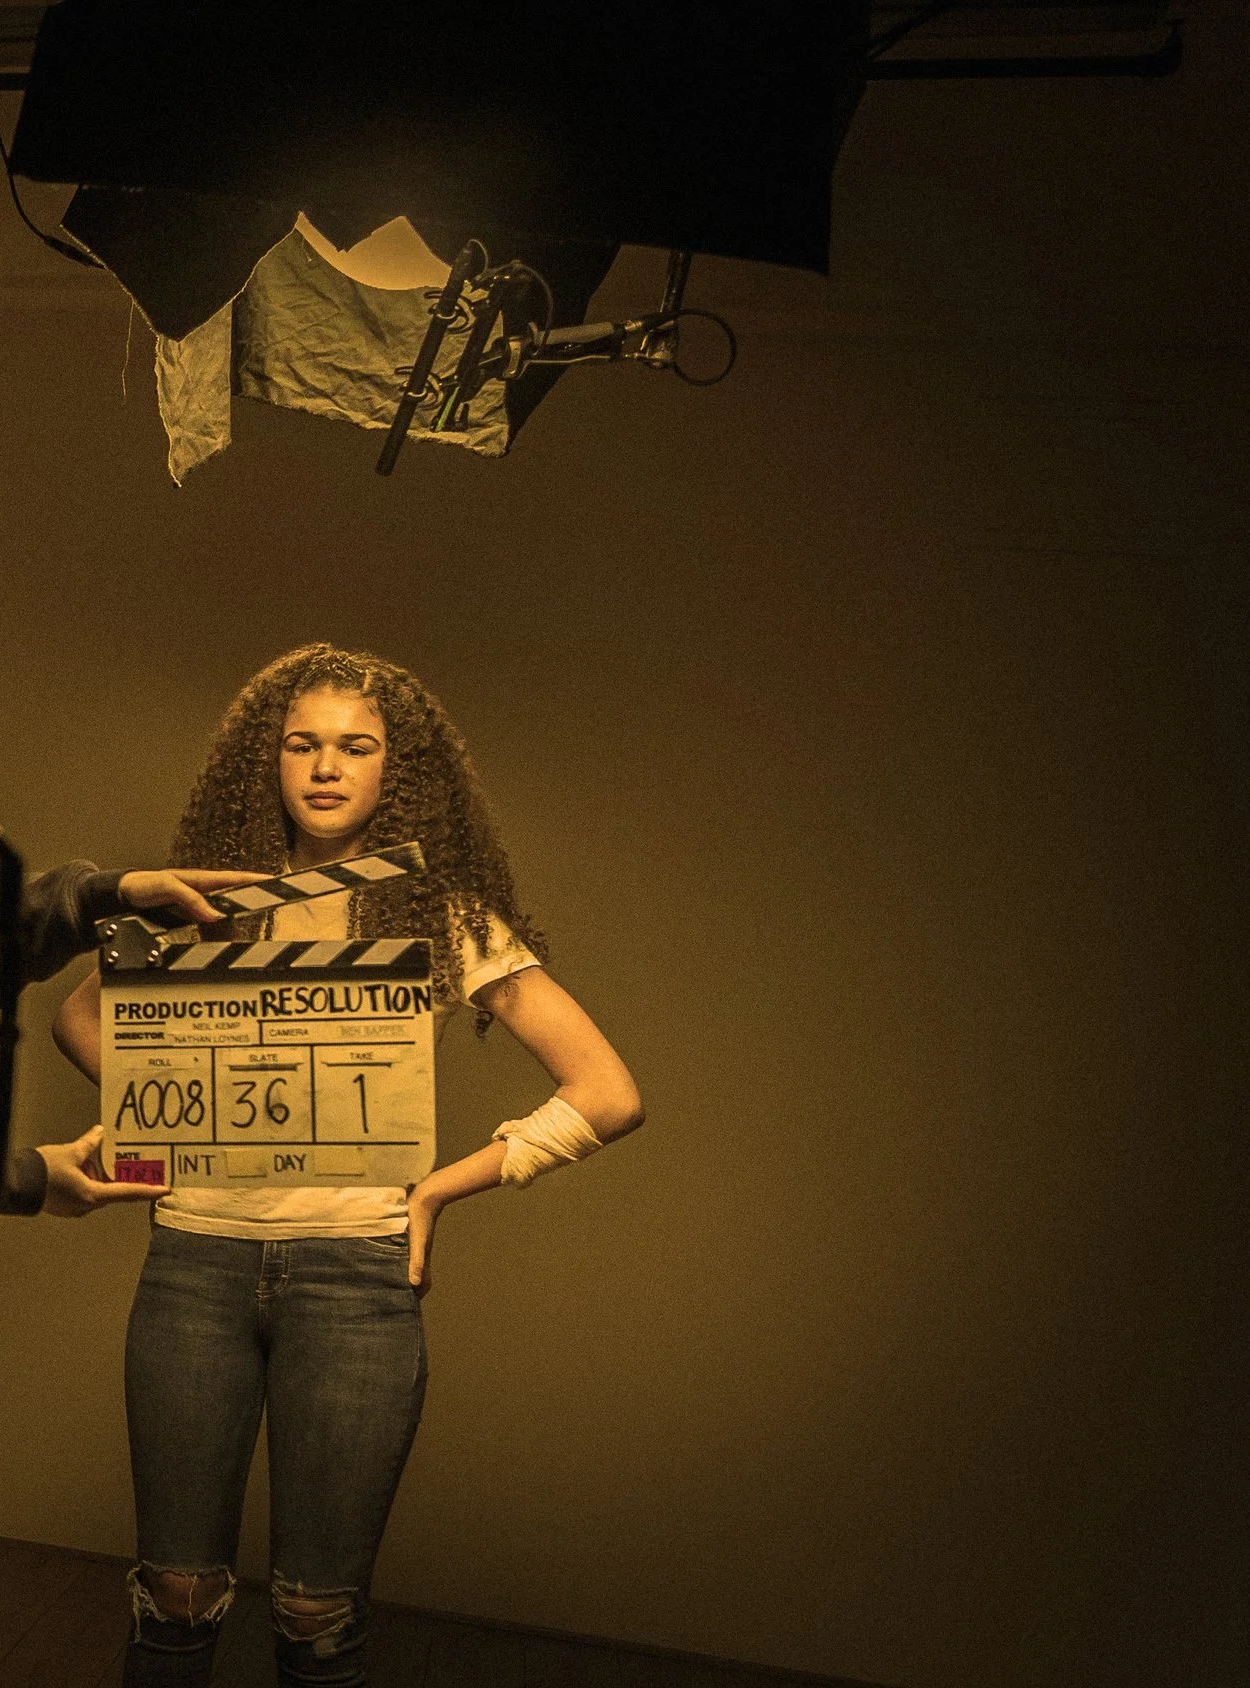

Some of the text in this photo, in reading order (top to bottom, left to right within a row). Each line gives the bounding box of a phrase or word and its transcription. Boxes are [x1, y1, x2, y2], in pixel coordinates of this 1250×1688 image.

[260, 984, 432, 1017] RESOLUTION
[114, 1000, 257, 1020] PRODUCTION
[192, 1022, 240, 1031] NEIL KEMP
[114, 1031, 165, 1041] DIRECTOR
[269, 1027, 308, 1037] CAMERA
[174, 1034, 211, 1043] NATHAN
[249, 1053, 278, 1062] SLATE
[350, 1052, 373, 1061] TAKE
[148, 1058, 171, 1067] ROLL
[115, 1080, 205, 1131] A008
[231, 1078, 290, 1128] 36
[353, 1073, 368, 1134] 1
[115, 1152, 140, 1161] DATE
[178, 1153, 216, 1176] INT
[273, 1153, 307, 1172] DAY
